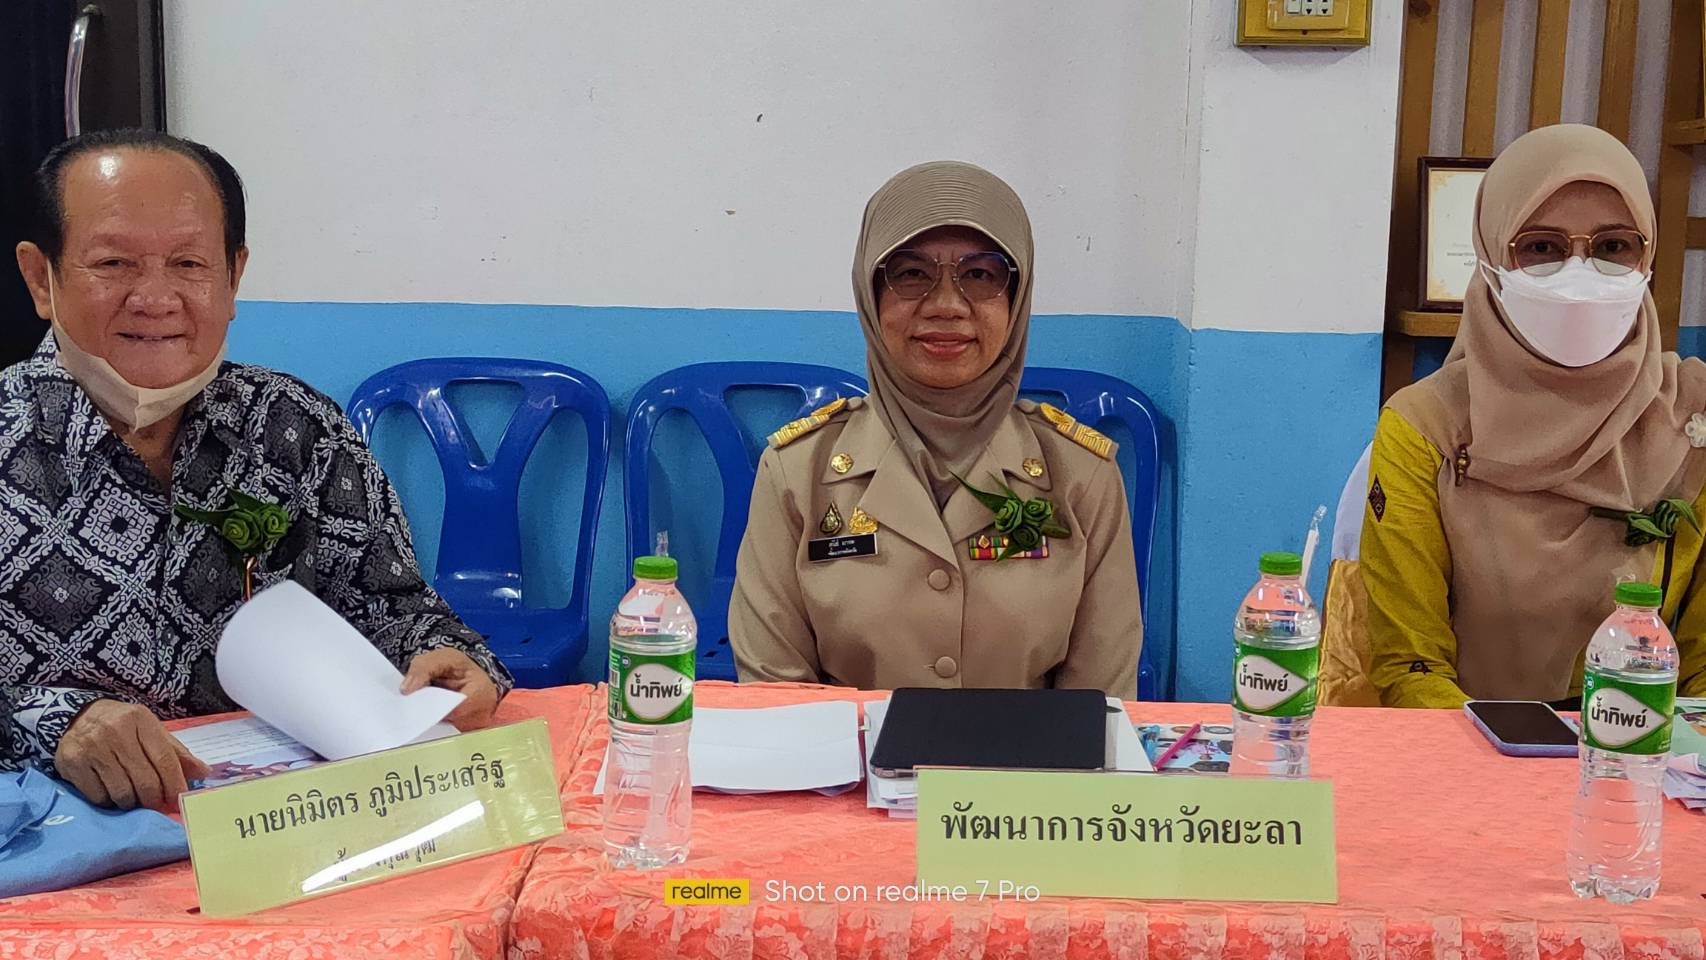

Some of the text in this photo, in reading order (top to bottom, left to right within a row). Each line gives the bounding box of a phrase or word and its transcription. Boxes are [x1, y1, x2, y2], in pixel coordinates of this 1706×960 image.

[630, 673, 683, 698] น้ำทิพย์
[1239, 663, 1289, 692] น้ำทิพย์
[1591, 696, 1648, 728] น้ำทิพย์
[234, 753, 506, 839] นายนิมิตร ภูมิประเสริฐ
[940, 801, 1302, 845] พัฒนาการจังหวัดยะลา
